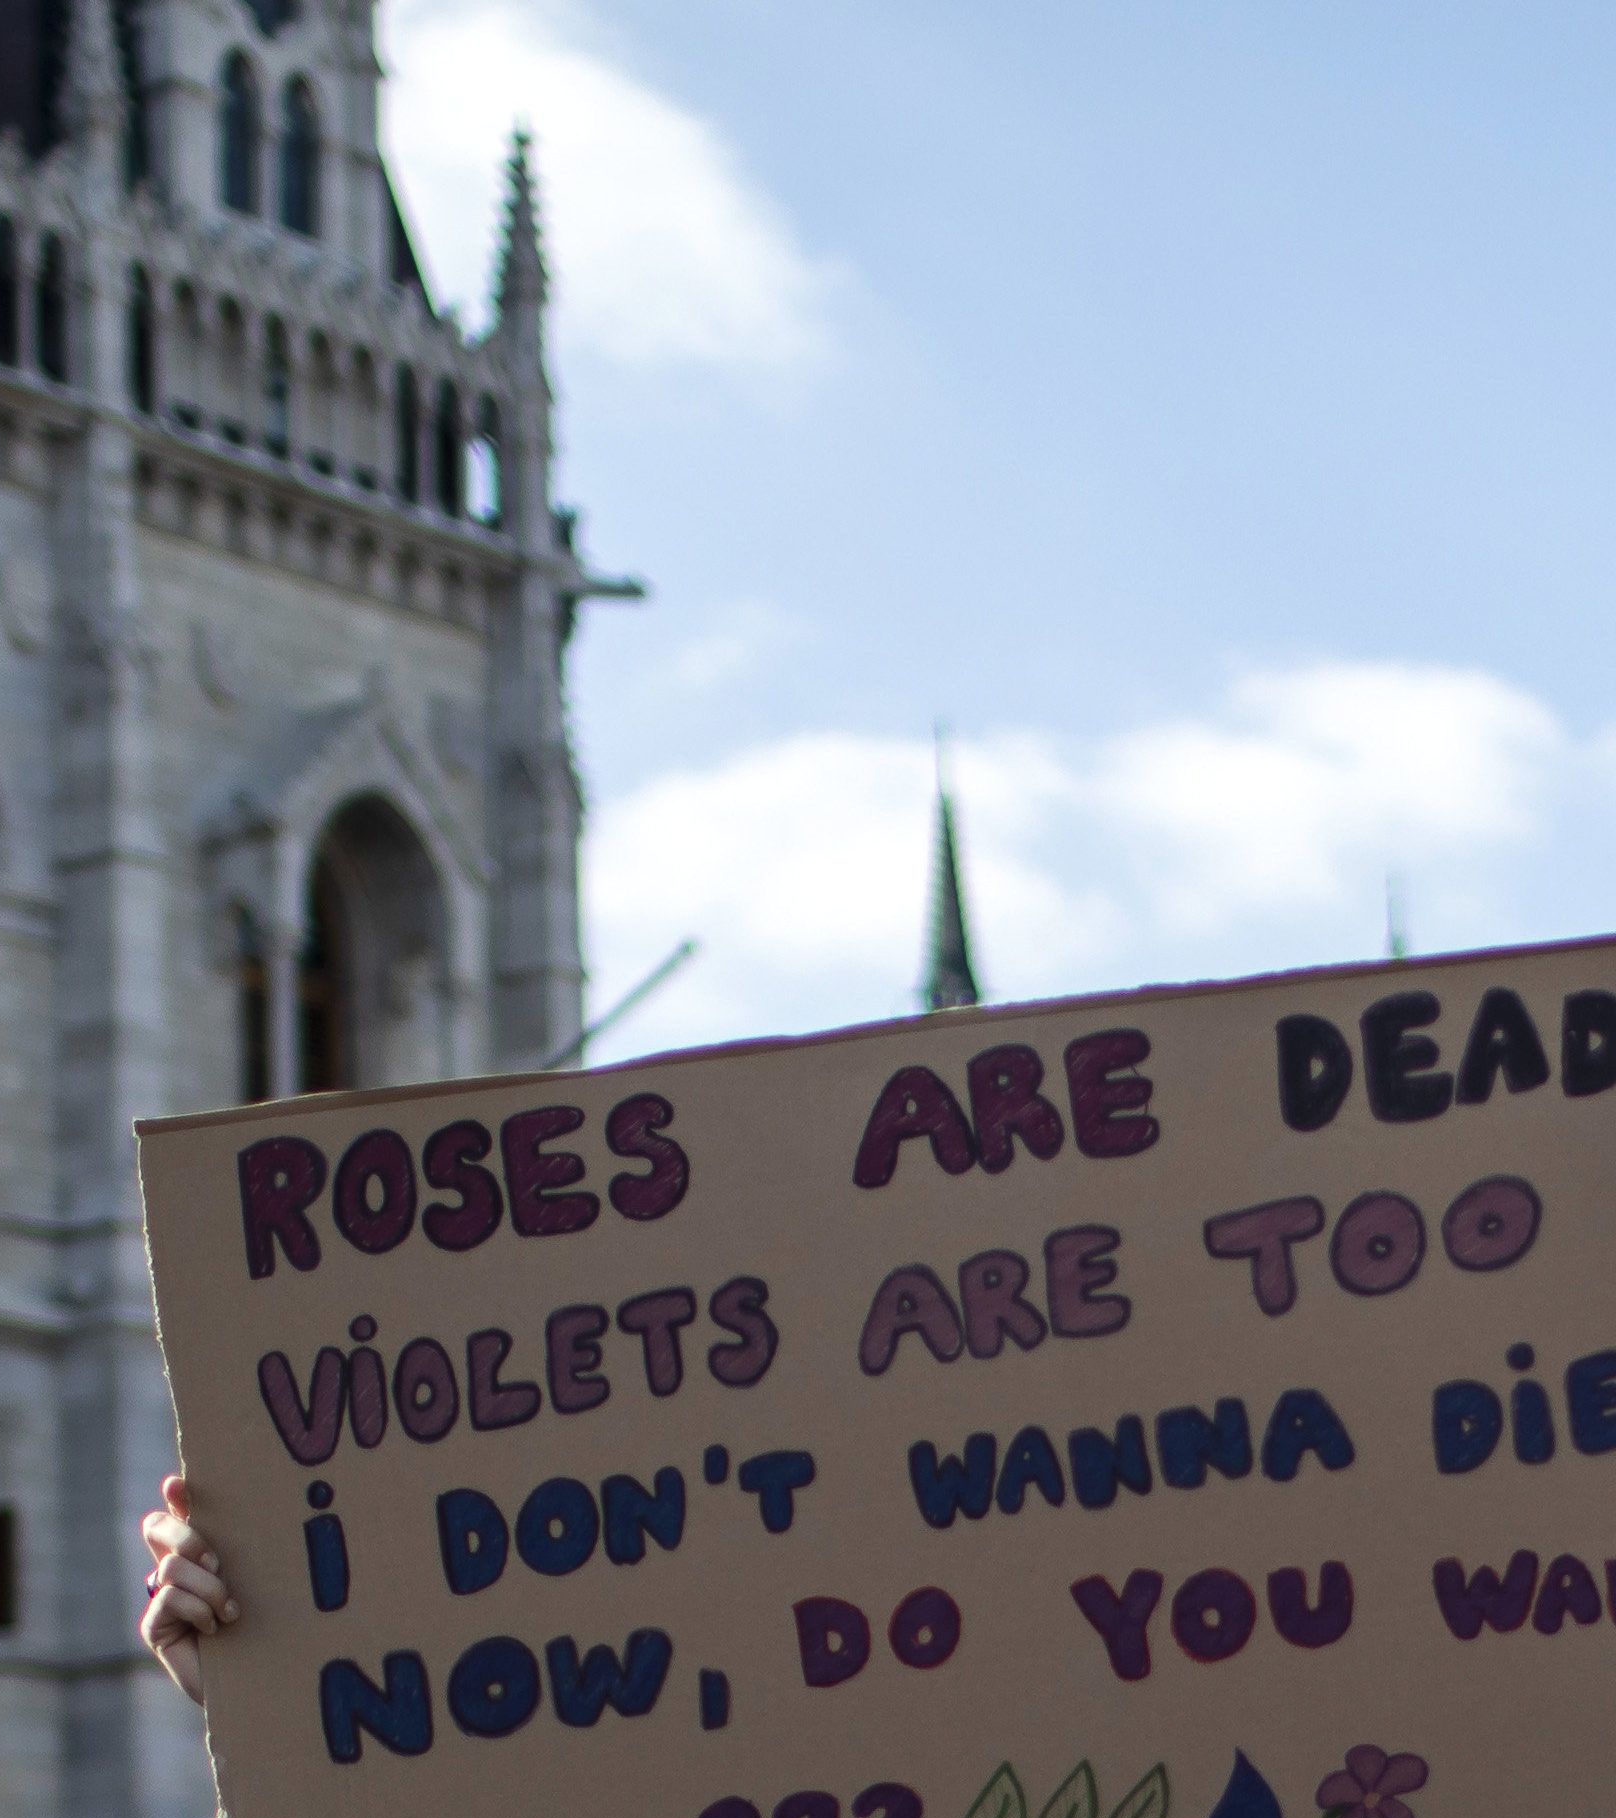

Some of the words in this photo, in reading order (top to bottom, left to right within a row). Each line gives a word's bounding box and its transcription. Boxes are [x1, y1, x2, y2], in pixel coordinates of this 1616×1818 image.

[238, 1091, 689, 1280] ROSES
[852, 1027, 1161, 1190] ARE
[859, 1222, 1132, 1376] ARE
[1203, 1174, 1543, 1316] TOO
[436, 1444, 817, 1595] DON'T
[907, 1387, 1355, 1531] WANNA
[319, 1627, 731, 1765] NOW,
[792, 1586, 962, 1690] DO
[1069, 1560, 1356, 1683] YOU
